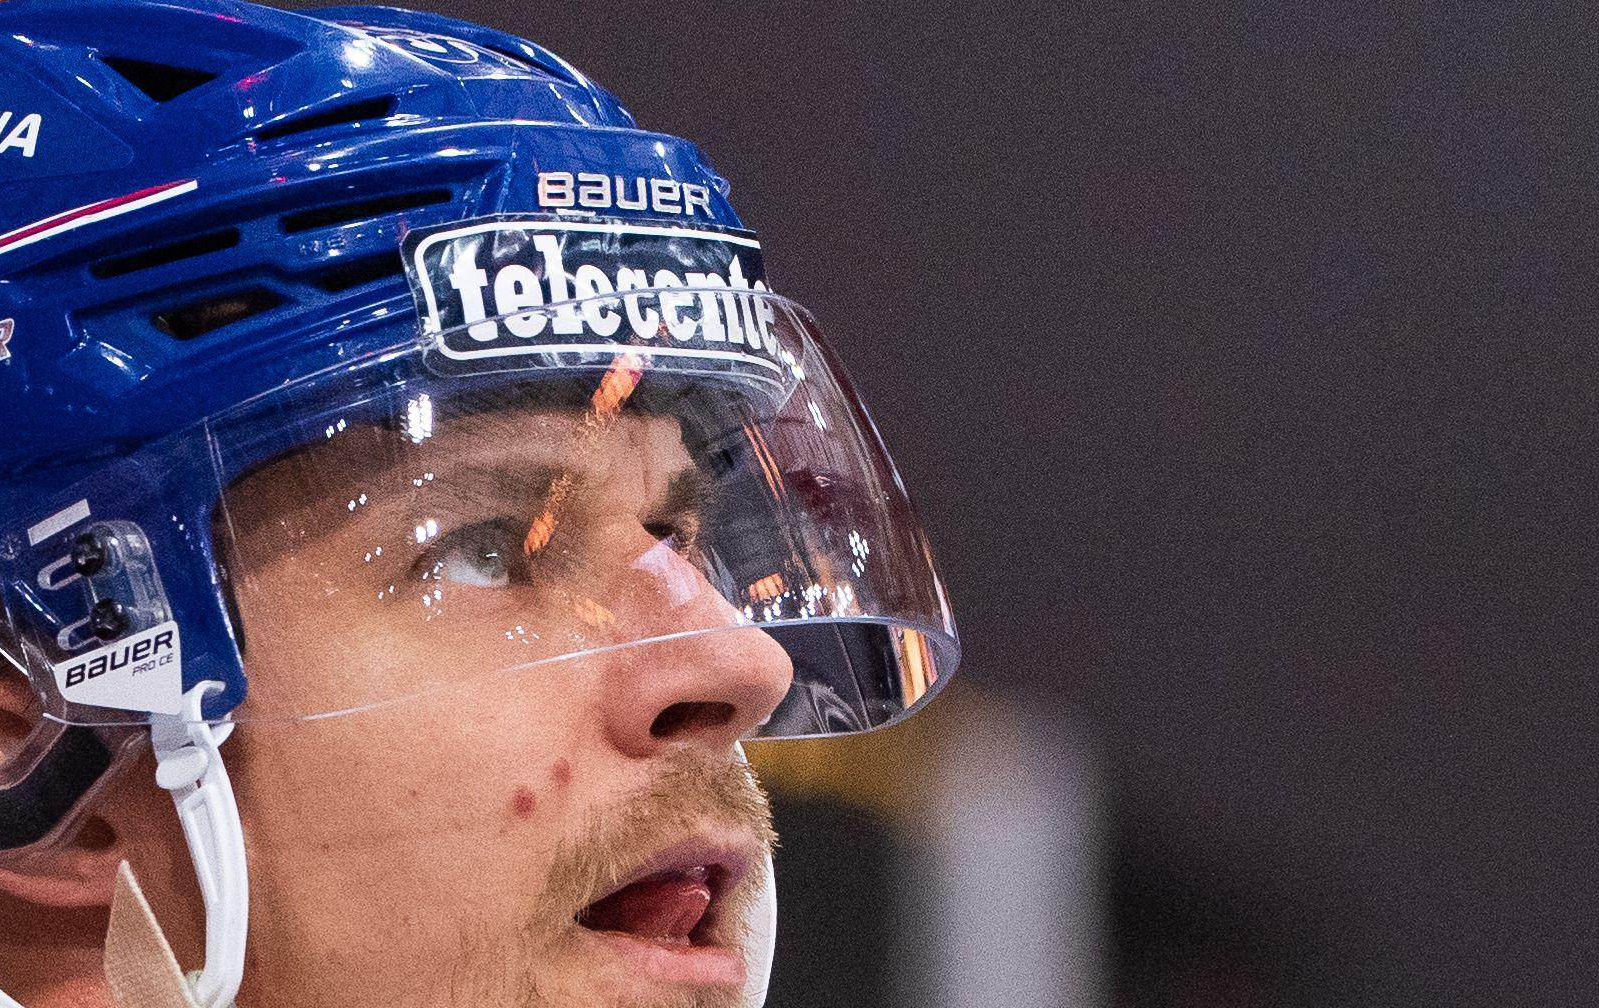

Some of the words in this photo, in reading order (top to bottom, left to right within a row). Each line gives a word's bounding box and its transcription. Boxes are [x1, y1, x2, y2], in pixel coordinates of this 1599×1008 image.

[537, 171, 716, 220] BAUER
[65, 630, 174, 688] BAUER
[131, 660, 157, 677] PRO
[159, 652, 174, 667] CE
